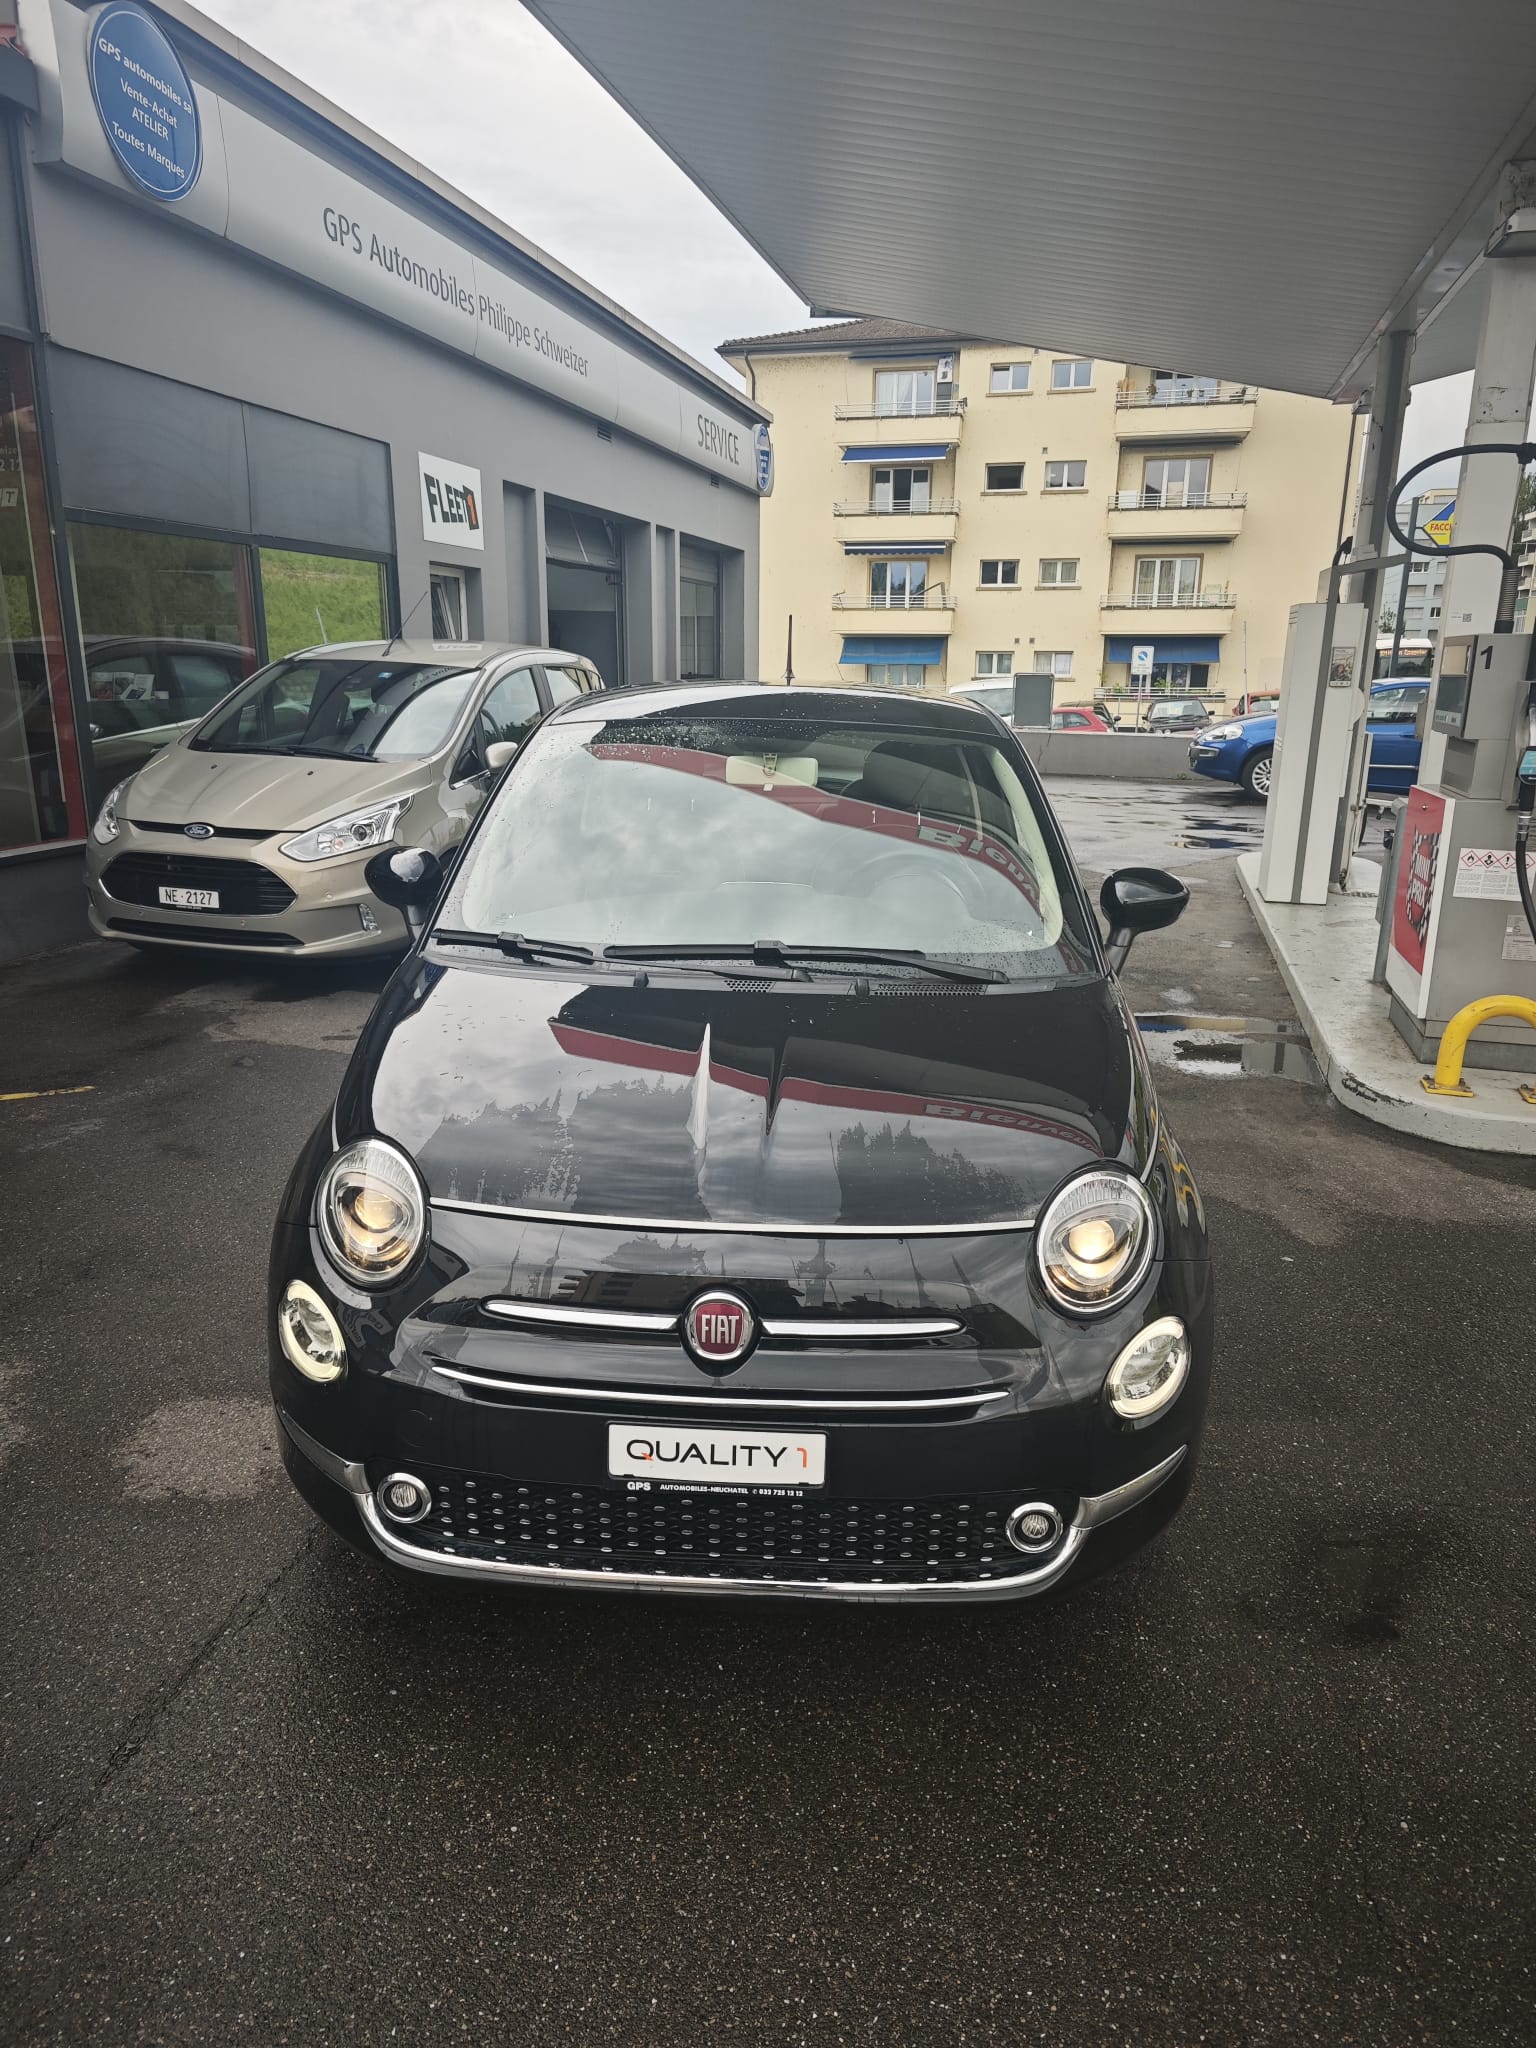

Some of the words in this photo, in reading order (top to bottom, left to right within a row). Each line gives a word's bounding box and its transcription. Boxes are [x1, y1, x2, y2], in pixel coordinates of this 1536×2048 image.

[98, 38, 121, 61] GPS
[123, 56, 182, 106] automobiles
[121, 77, 178, 129] Vente-Achat
[132, 107, 169, 141] ATELIER
[112, 121, 145, 152] Toutes
[147, 144, 185, 179] Marques
[323, 208, 363, 254] GPS
[370, 234, 475, 316] Automobiles
[479, 294, 531, 347] Philippe
[534, 327, 589, 378] Schweizer
[697, 414, 740, 466] SERVICE
[1480, 645, 1493, 670] 1
[1414, 853, 1431, 882] MINI
[165, 889, 178, 902] NE
[186, 891, 212, 905] 2127
[1411, 880, 1427, 909] PRIX
[701, 1313, 740, 1344] FIAT
[627, 1439, 788, 1468] QUALITY
[796, 1447, 808, 1468] 1
[627, 1482, 651, 1491] GPS
[660, 1484, 748, 1494] AUTOMOBILES-NEUCHATEL
